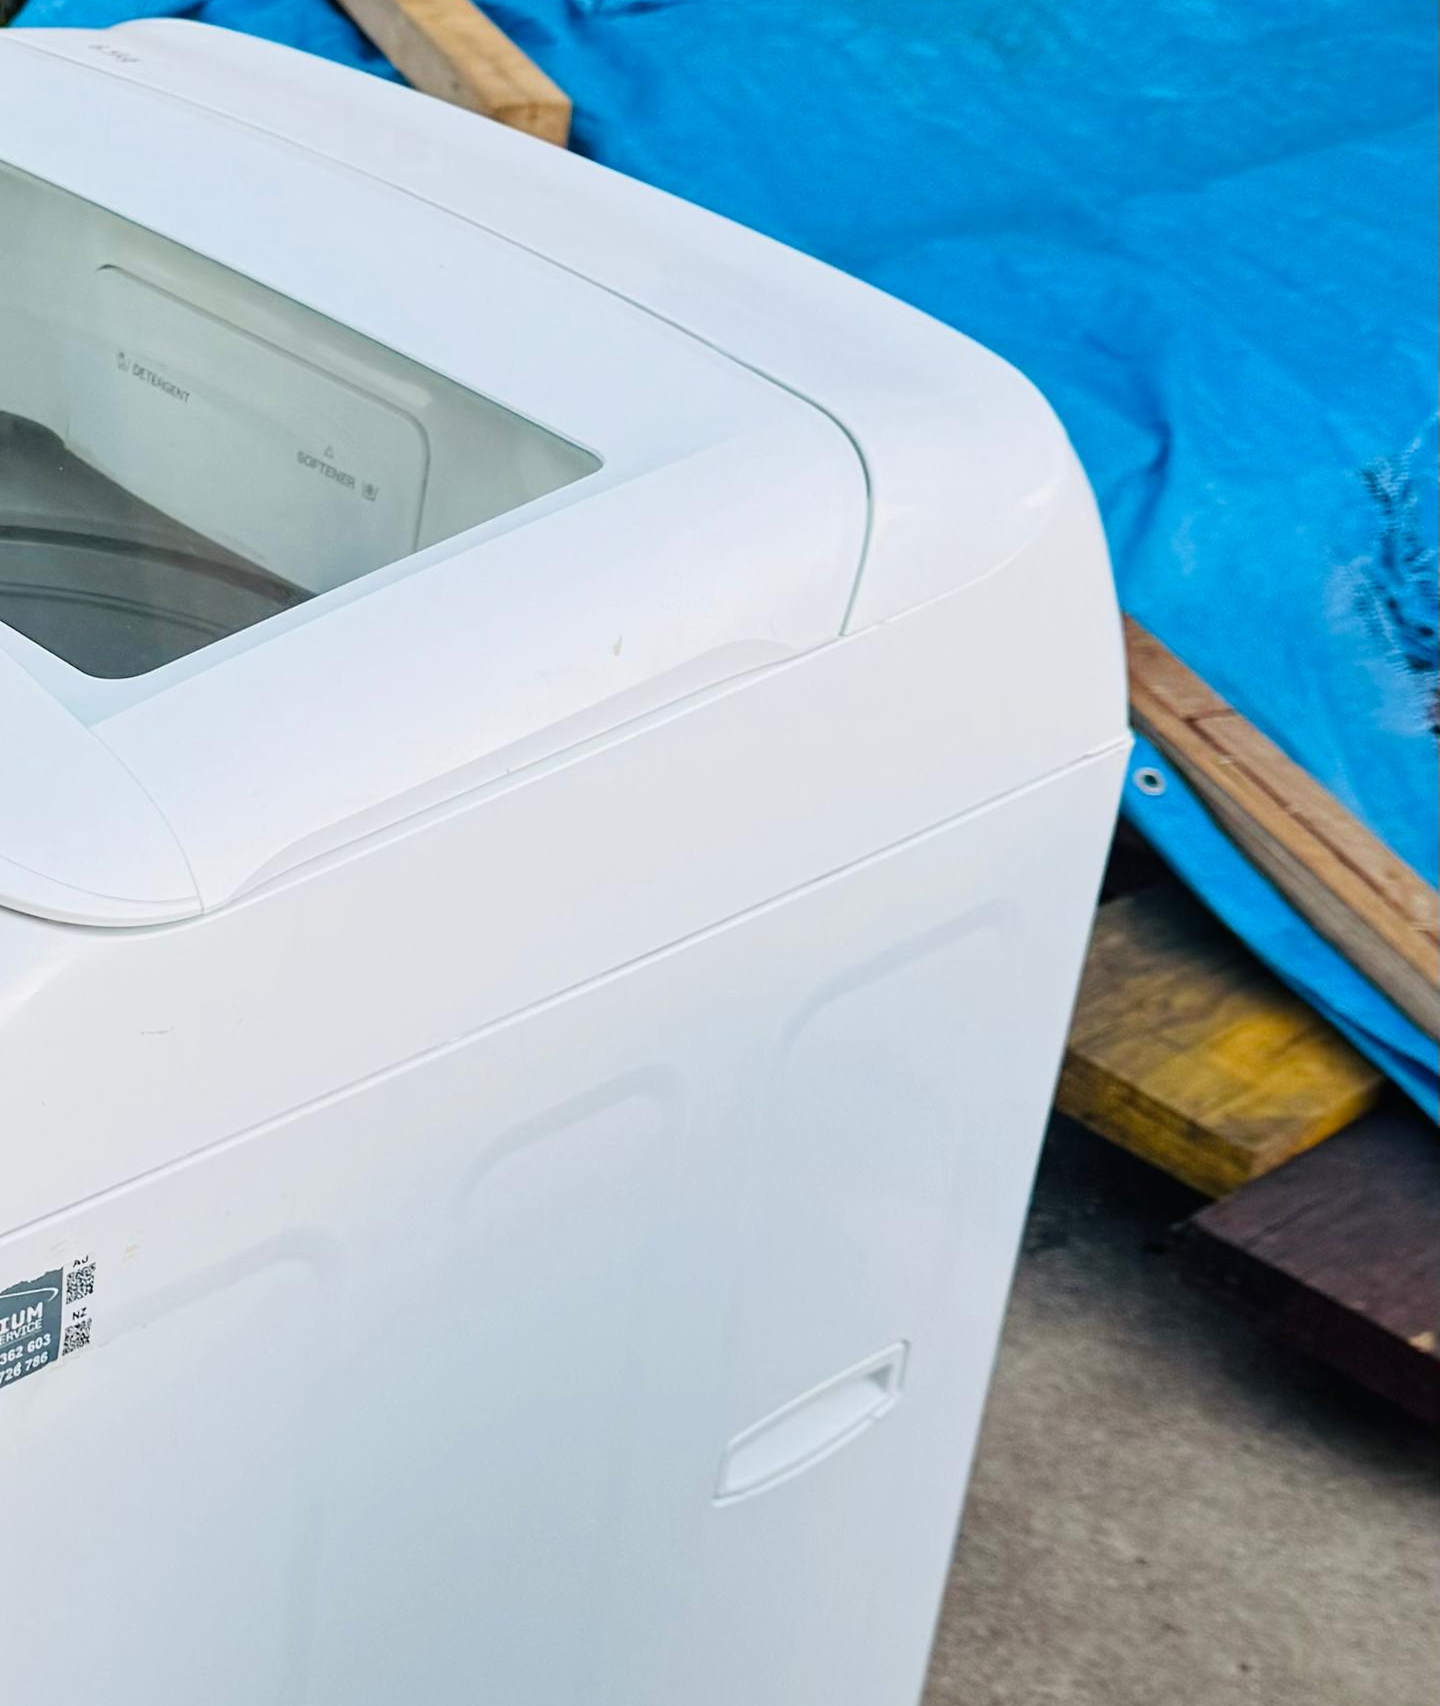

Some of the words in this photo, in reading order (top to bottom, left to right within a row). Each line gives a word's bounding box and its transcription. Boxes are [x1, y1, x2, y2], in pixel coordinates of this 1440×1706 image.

[132, 363, 191, 403] DETERGENT
[297, 450, 356, 489] SOFTENER
[72, 1307, 87, 1321] NZ
[0, 1346, 24, 1365] 362
[27, 1334, 51, 1353] 603
[25, 1352, 48, 1371] 786
